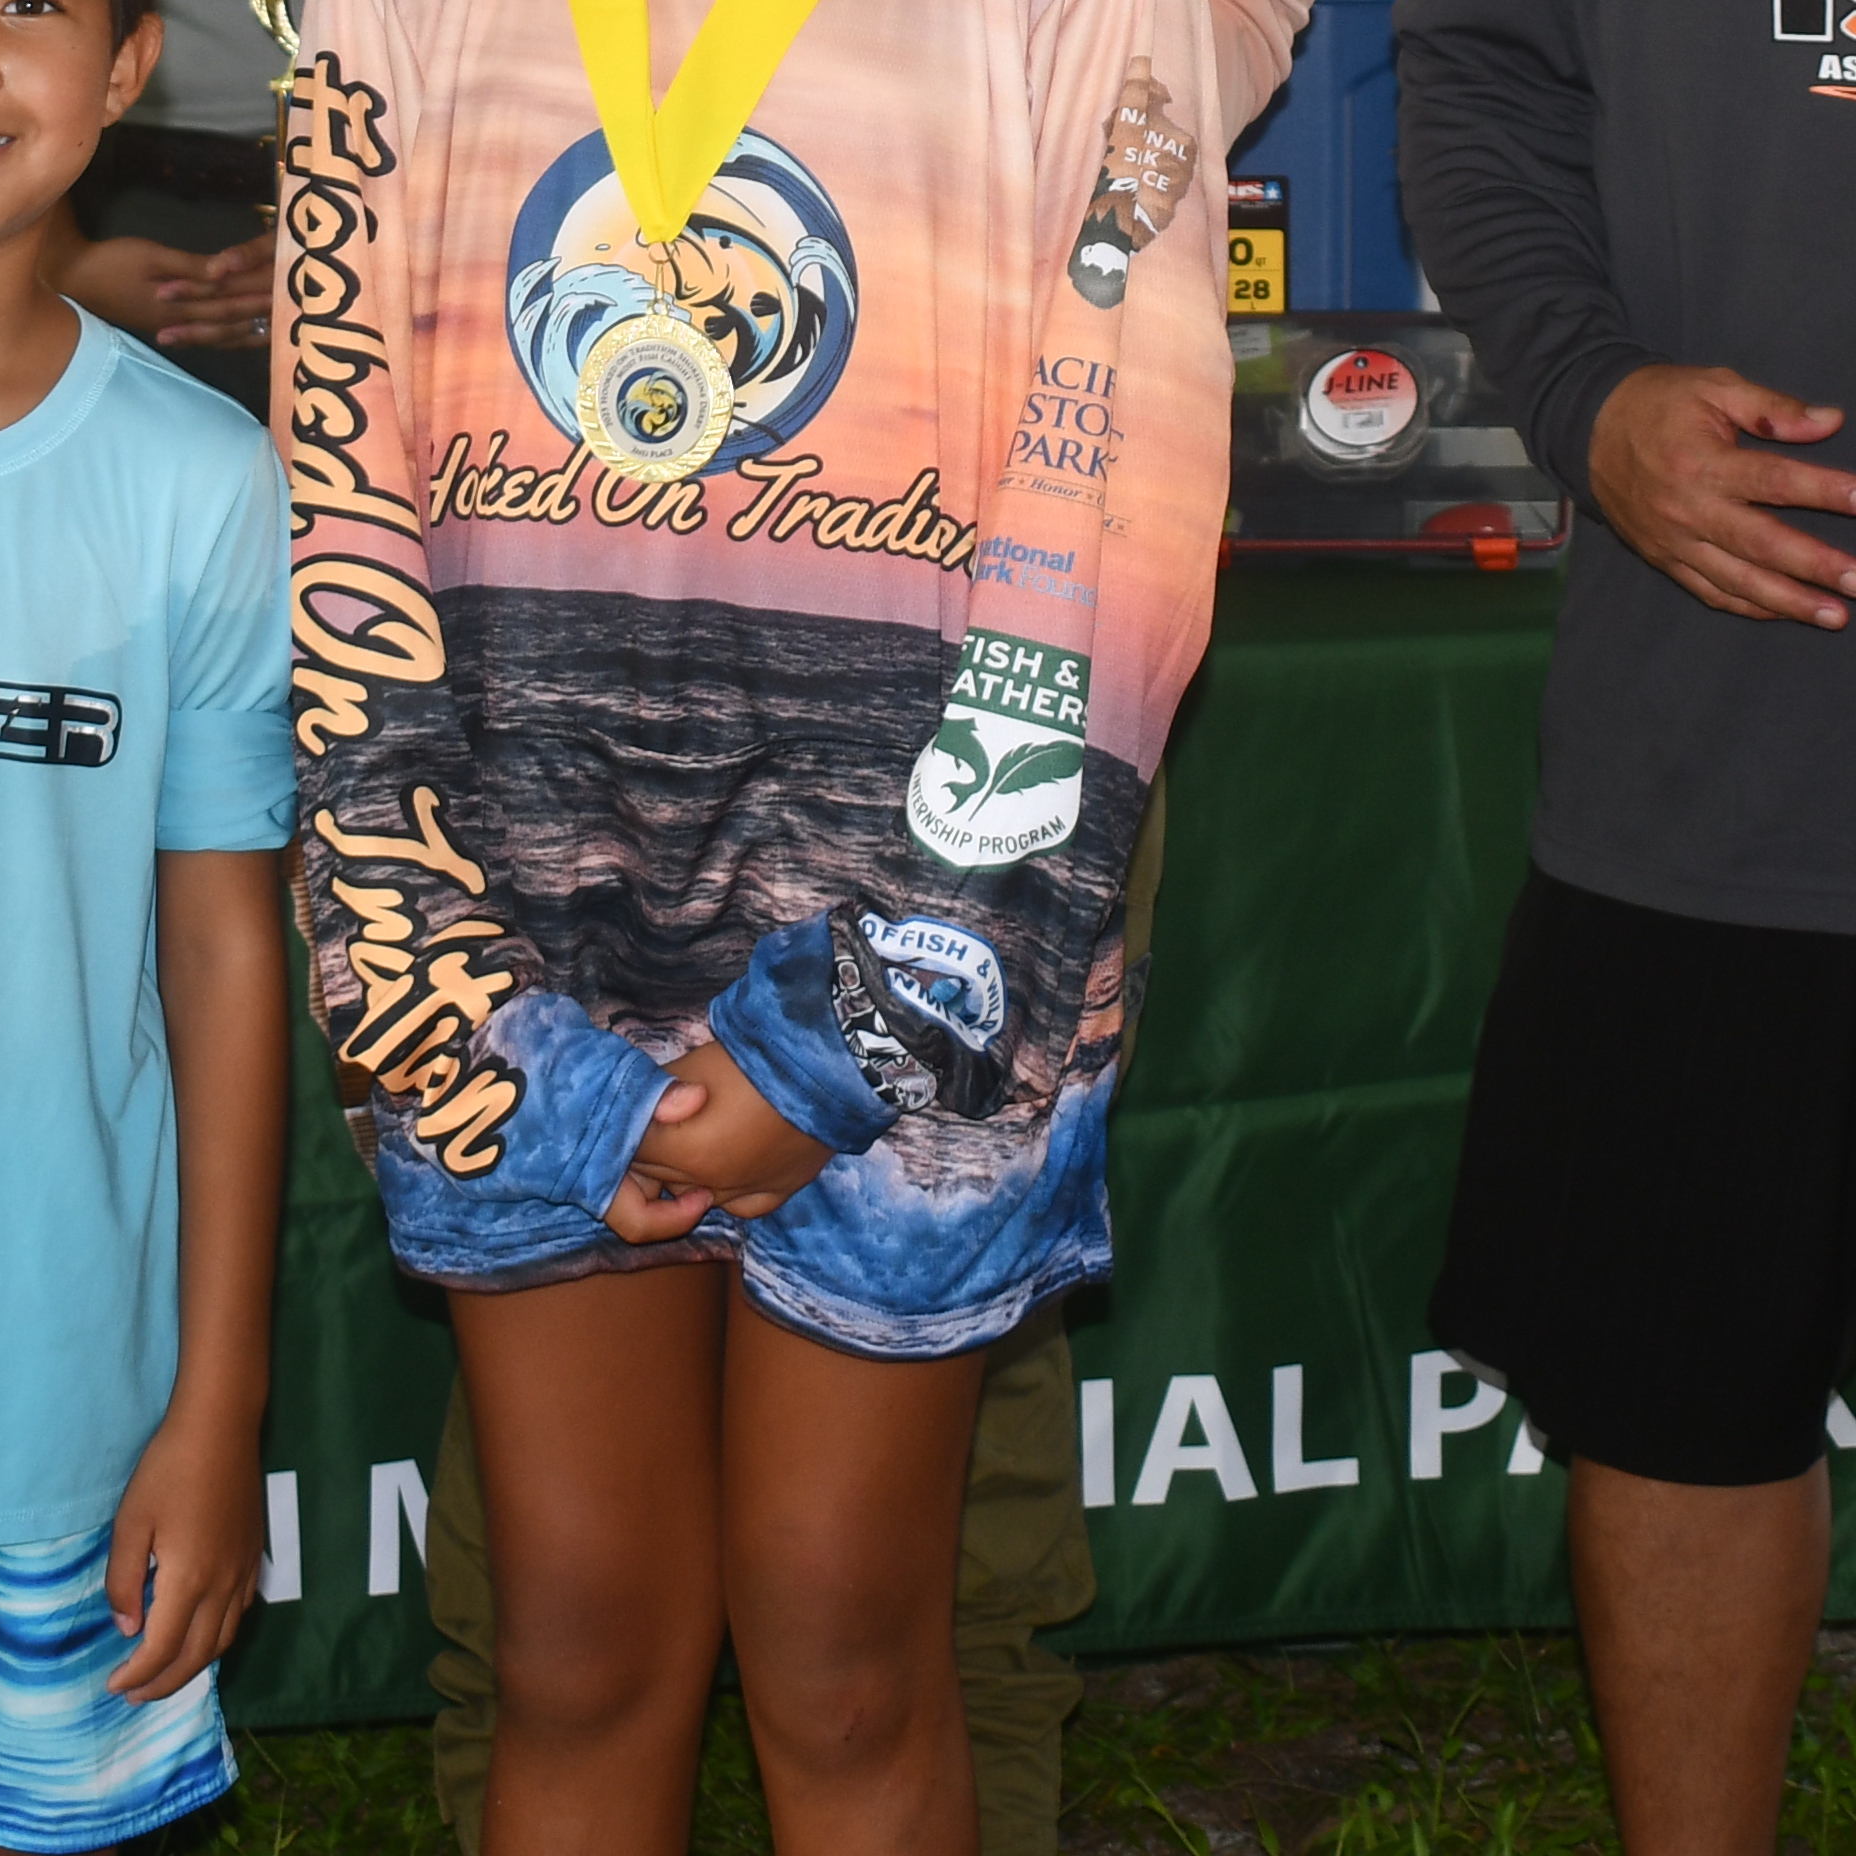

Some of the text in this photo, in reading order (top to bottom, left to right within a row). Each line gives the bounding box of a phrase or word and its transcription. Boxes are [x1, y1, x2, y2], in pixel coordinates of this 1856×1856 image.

[1234, 278, 1271, 301] 28
[1322, 372, 1400, 396] J-LINE
[1030, 478, 1083, 499] Honor
[290, 552, 448, 759] On
[1058, 656, 1081, 690] &
[911, 770, 1069, 856] INTERNSHIP PROGRAM
